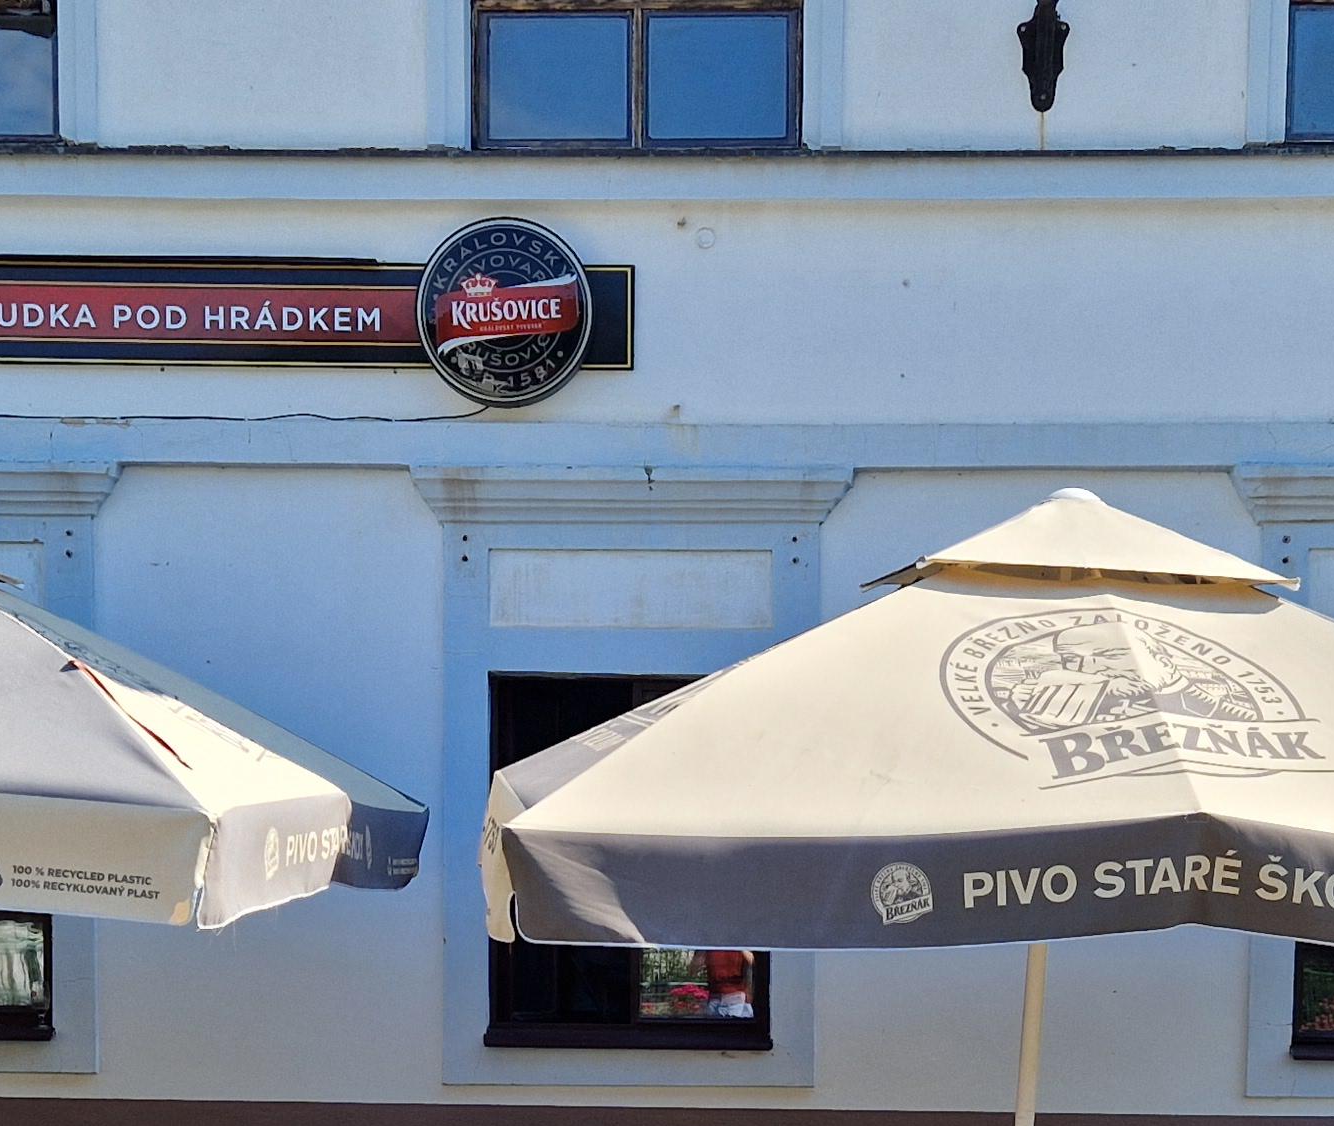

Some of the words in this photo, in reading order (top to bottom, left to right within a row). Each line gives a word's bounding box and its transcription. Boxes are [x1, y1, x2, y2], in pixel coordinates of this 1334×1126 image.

[113, 304, 188, 331] POD
[204, 301, 383, 333] HRÁDKEM
[451, 297, 562, 330] KRUŠOVICE
[962, 619, 1057, 660] BŘEZNO
[1069, 613, 1232, 666] ZALOŽENO
[950, 662, 992, 716] VELKÉ
[1237, 671, 1283, 704] 1753
[1039, 719, 1327, 780] BŘEZŇÁK
[285, 831, 318, 867] PIVO
[10, 877, 41, 889] 100%
[43, 880, 125, 897] RECYKLOVANÝ
[126, 888, 161, 900] PLAST
[12, 864, 33, 876] 100
[47, 867, 105, 882] RECYCLED
[107, 873, 153, 886] PLASTIC
[963, 864, 1078, 908] PIVO
[1093, 850, 1243, 899] STARÉ
